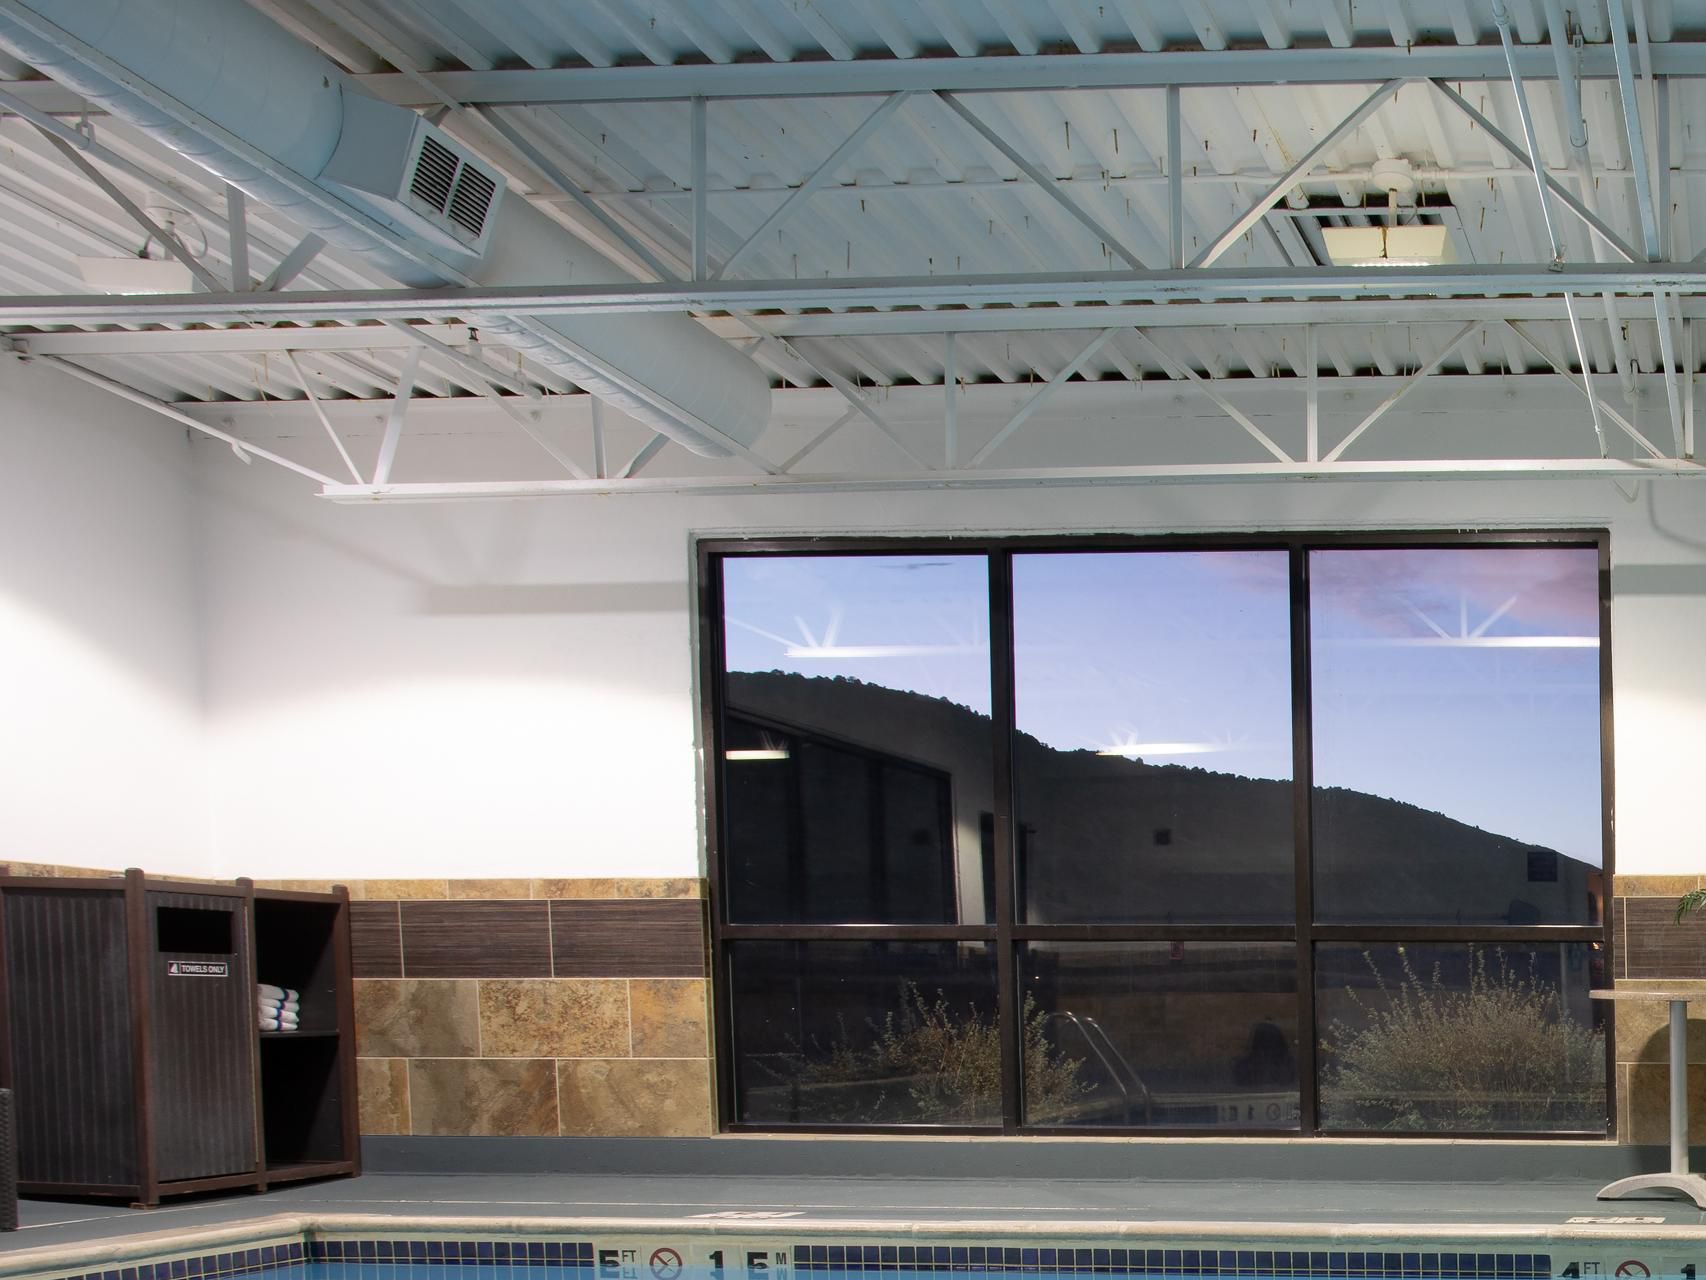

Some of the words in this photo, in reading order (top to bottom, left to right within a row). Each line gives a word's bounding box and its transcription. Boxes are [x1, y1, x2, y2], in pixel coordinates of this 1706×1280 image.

[181, 964, 208, 973] TOWELS
[208, 965, 225, 974] ONLY
[622, 1250, 636, 1262] FT
[709, 1250, 724, 1269] 1
[776, 1252, 787, 1265] M
[1584, 1261, 1601, 1275] FT
